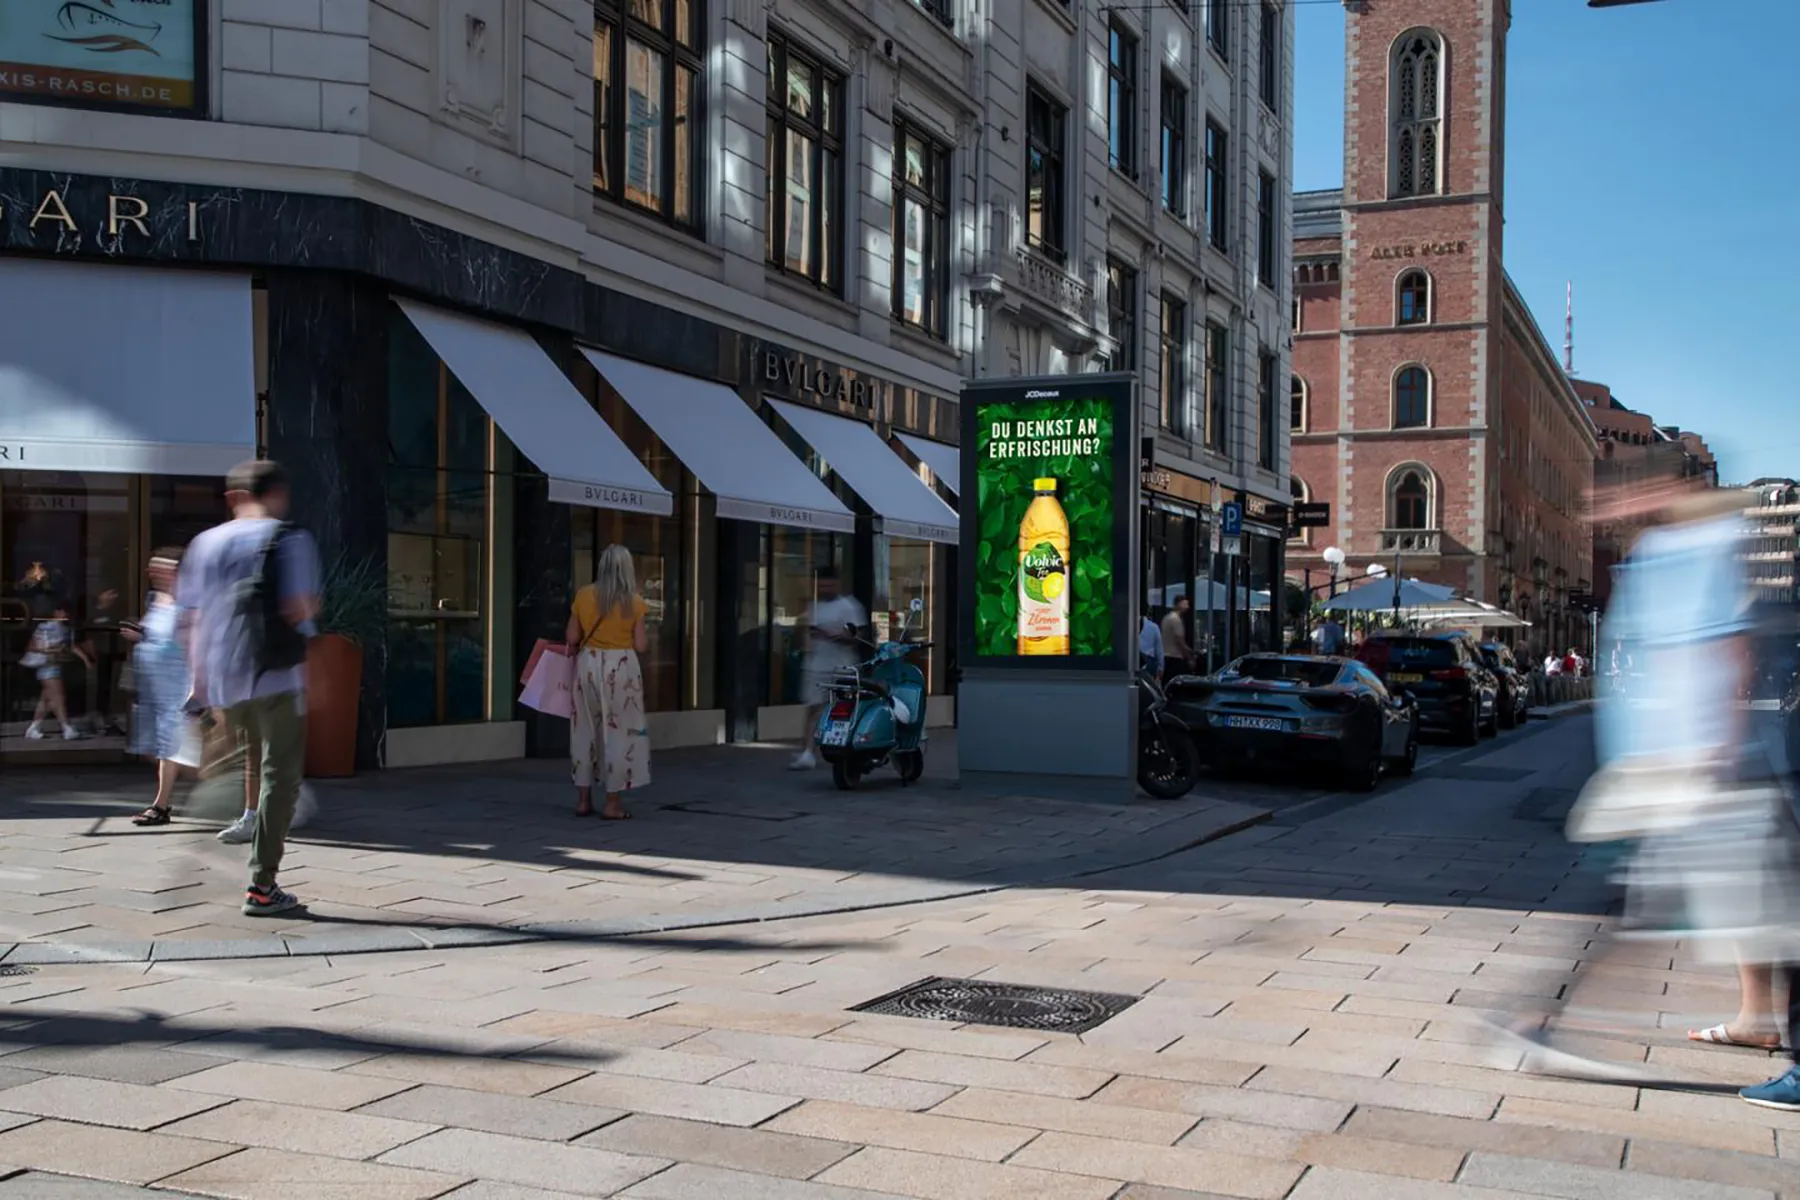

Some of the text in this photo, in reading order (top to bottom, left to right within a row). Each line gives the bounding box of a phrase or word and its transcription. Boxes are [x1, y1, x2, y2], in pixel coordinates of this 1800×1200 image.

[0, 189, 198, 241] ARI
[765, 352, 877, 410] BVLGARI
[1025, 390, 1060, 399] JCDecaux
[991, 418, 1097, 439] DU DENKST AN
[989, 437, 1101, 459] ERFRISCHUNG?
[584, 486, 643, 506] BVLGARI
[770, 507, 812, 523] BVLGARI
[1227, 506, 1238, 531] P
[1025, 555, 1063, 568] Volvic
